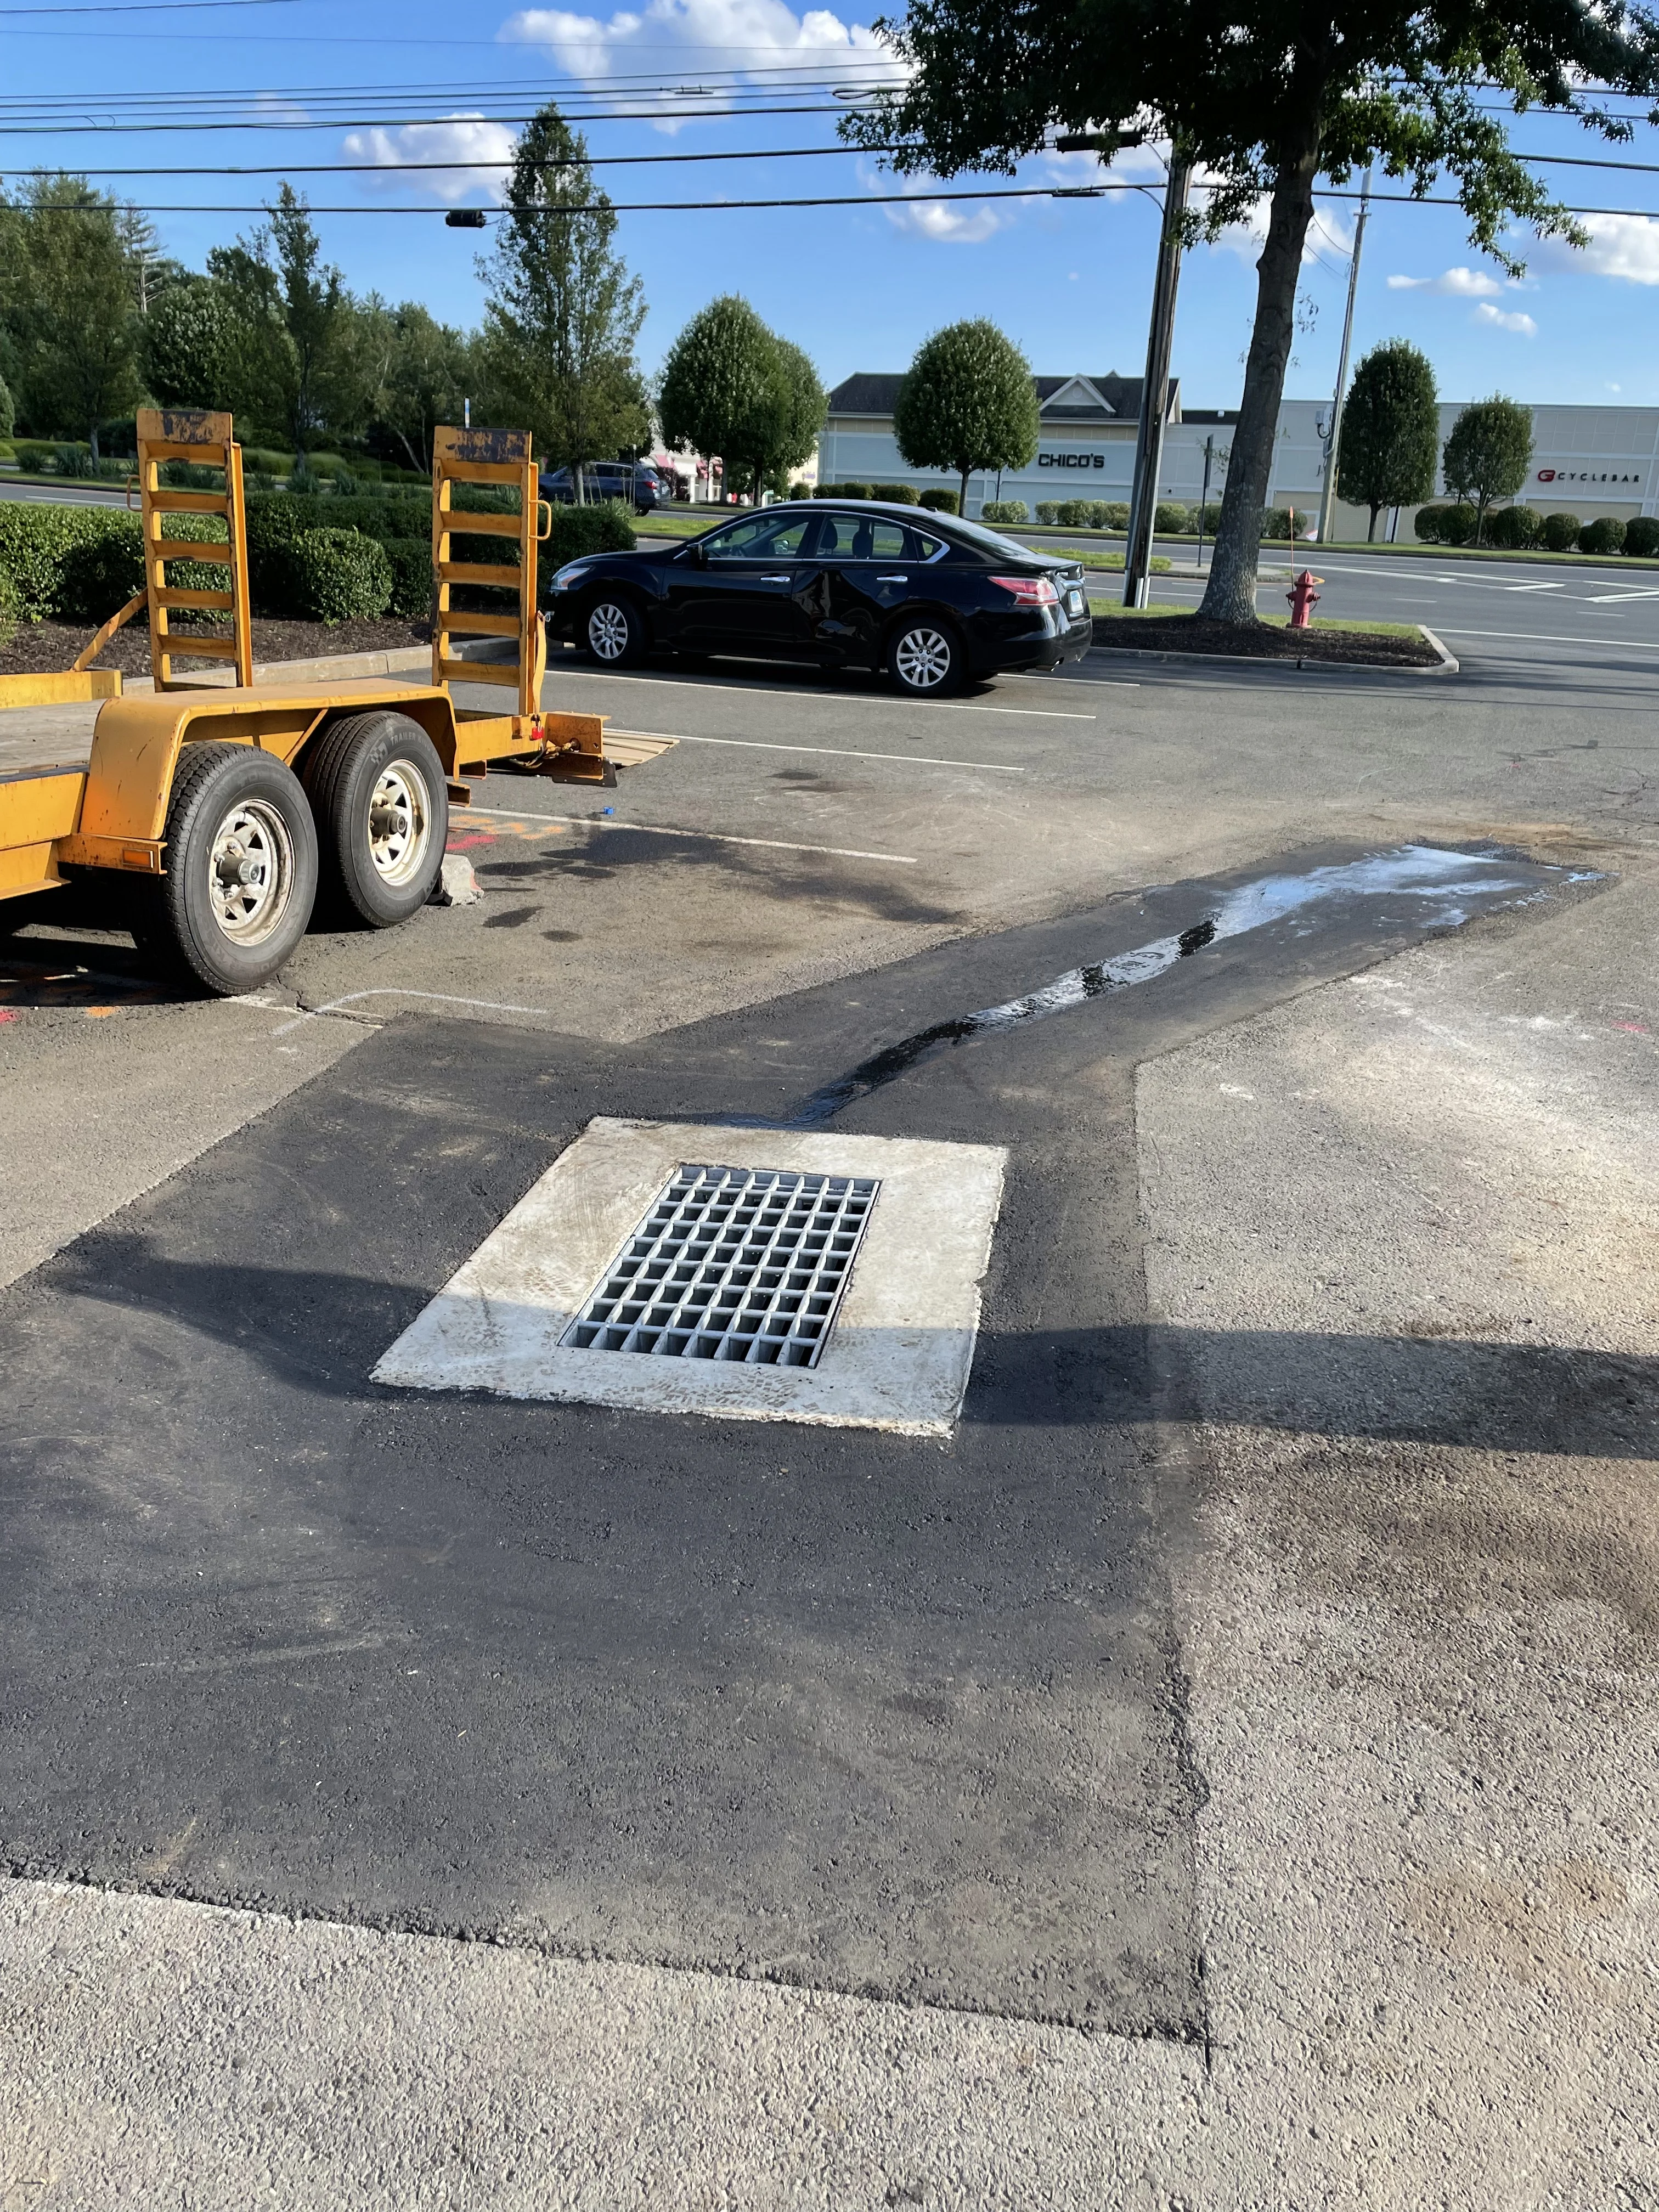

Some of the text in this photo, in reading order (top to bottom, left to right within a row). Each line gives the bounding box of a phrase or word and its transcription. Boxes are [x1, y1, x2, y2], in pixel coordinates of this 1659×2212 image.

[1038, 453, 1105, 468] CHICO'S
[1558, 472, 1640, 483] CYCLEBAR
[390, 731, 416, 746] TRAILER
